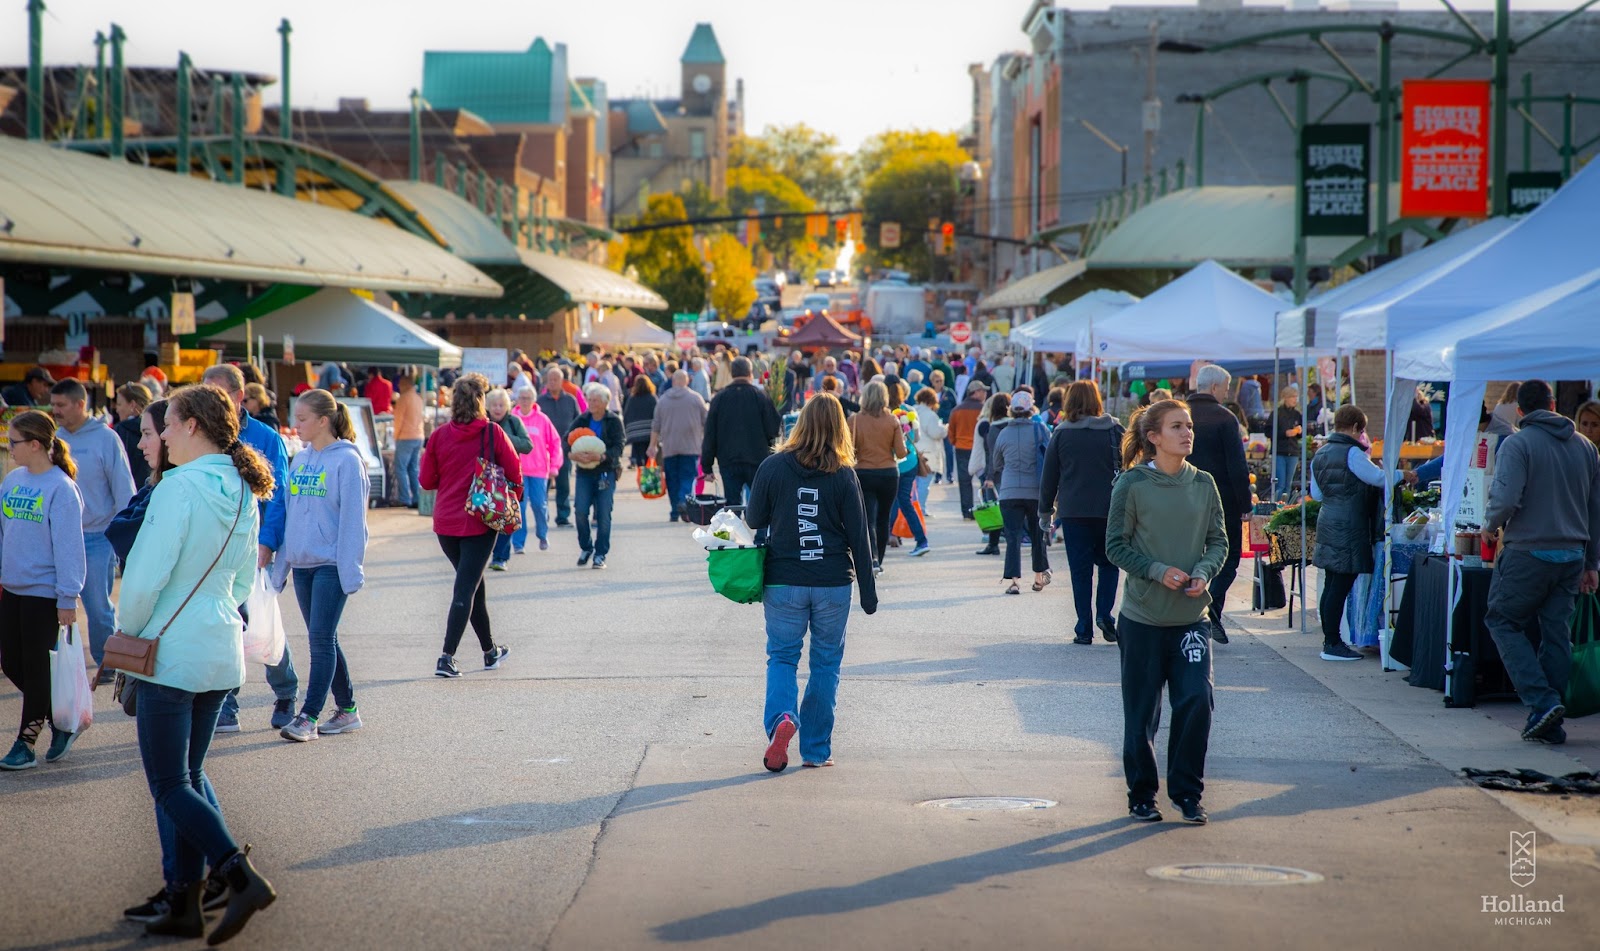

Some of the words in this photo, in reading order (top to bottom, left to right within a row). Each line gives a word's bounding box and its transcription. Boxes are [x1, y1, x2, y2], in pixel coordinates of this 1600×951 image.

[1413, 106, 1480, 121] EIGHTH
[1413, 119, 1480, 138] STREET
[1308, 144, 1364, 157] EIGHTH
[1412, 164, 1479, 176] MARKET
[1412, 175, 1479, 191] PLACE
[1308, 192, 1364, 203] MARKET
[1308, 202, 1364, 216] PLACE
[293, 475, 320, 486] STATE
[6, 497, 38, 511] STATE
[14, 510, 43, 524] softball
[797, 487, 824, 561] COACH
[1188, 649, 1202, 663] 15
